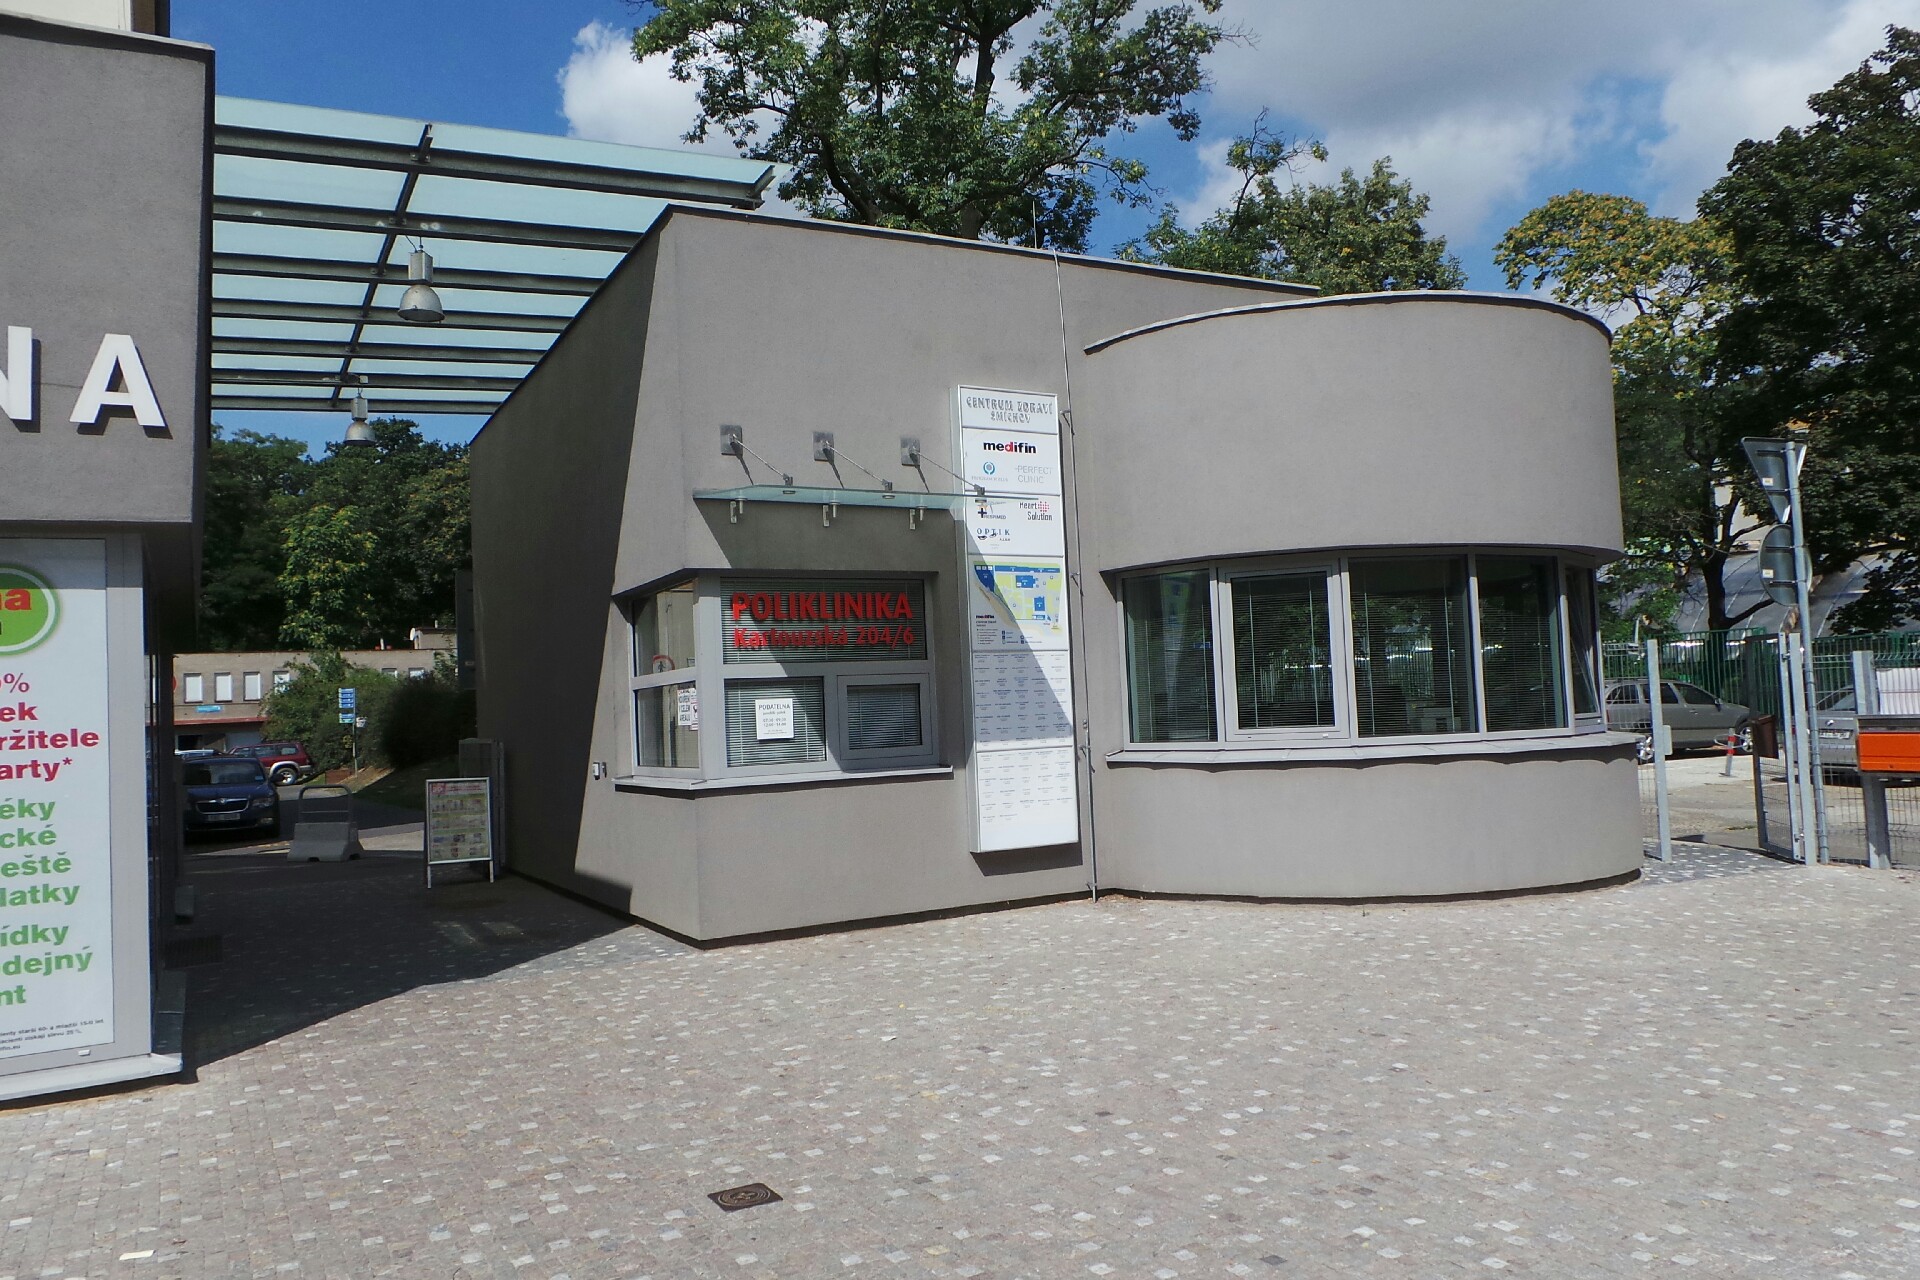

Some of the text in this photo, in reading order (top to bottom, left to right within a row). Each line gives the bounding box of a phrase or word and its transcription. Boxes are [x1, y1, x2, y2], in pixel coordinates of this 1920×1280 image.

[966, 396, 1053, 415] CENTRUM ZDRAVÍ
[989, 411, 1031, 423] SMÍCHOV
[983, 442, 1037, 454] medifin
[1017, 465, 1053, 475] PERFECT
[1017, 474, 1046, 484] CLINIC
[1019, 502, 1038, 510] Heart
[1027, 511, 1053, 521] Solution
[976, 528, 1010, 536] OPTIK
[0, 588, 32, 611] a
[732, 592, 913, 620] POLIKLINIKA
[734, 625, 915, 650] Kartouzská 204/6
[0, 798, 56, 821] éky
[0, 823, 57, 849] cké
[0, 851, 72, 878] eště
[0, 883, 80, 907] latky
[0, 924, 69, 947] ídky
[2, 945, 94, 976] dejný
